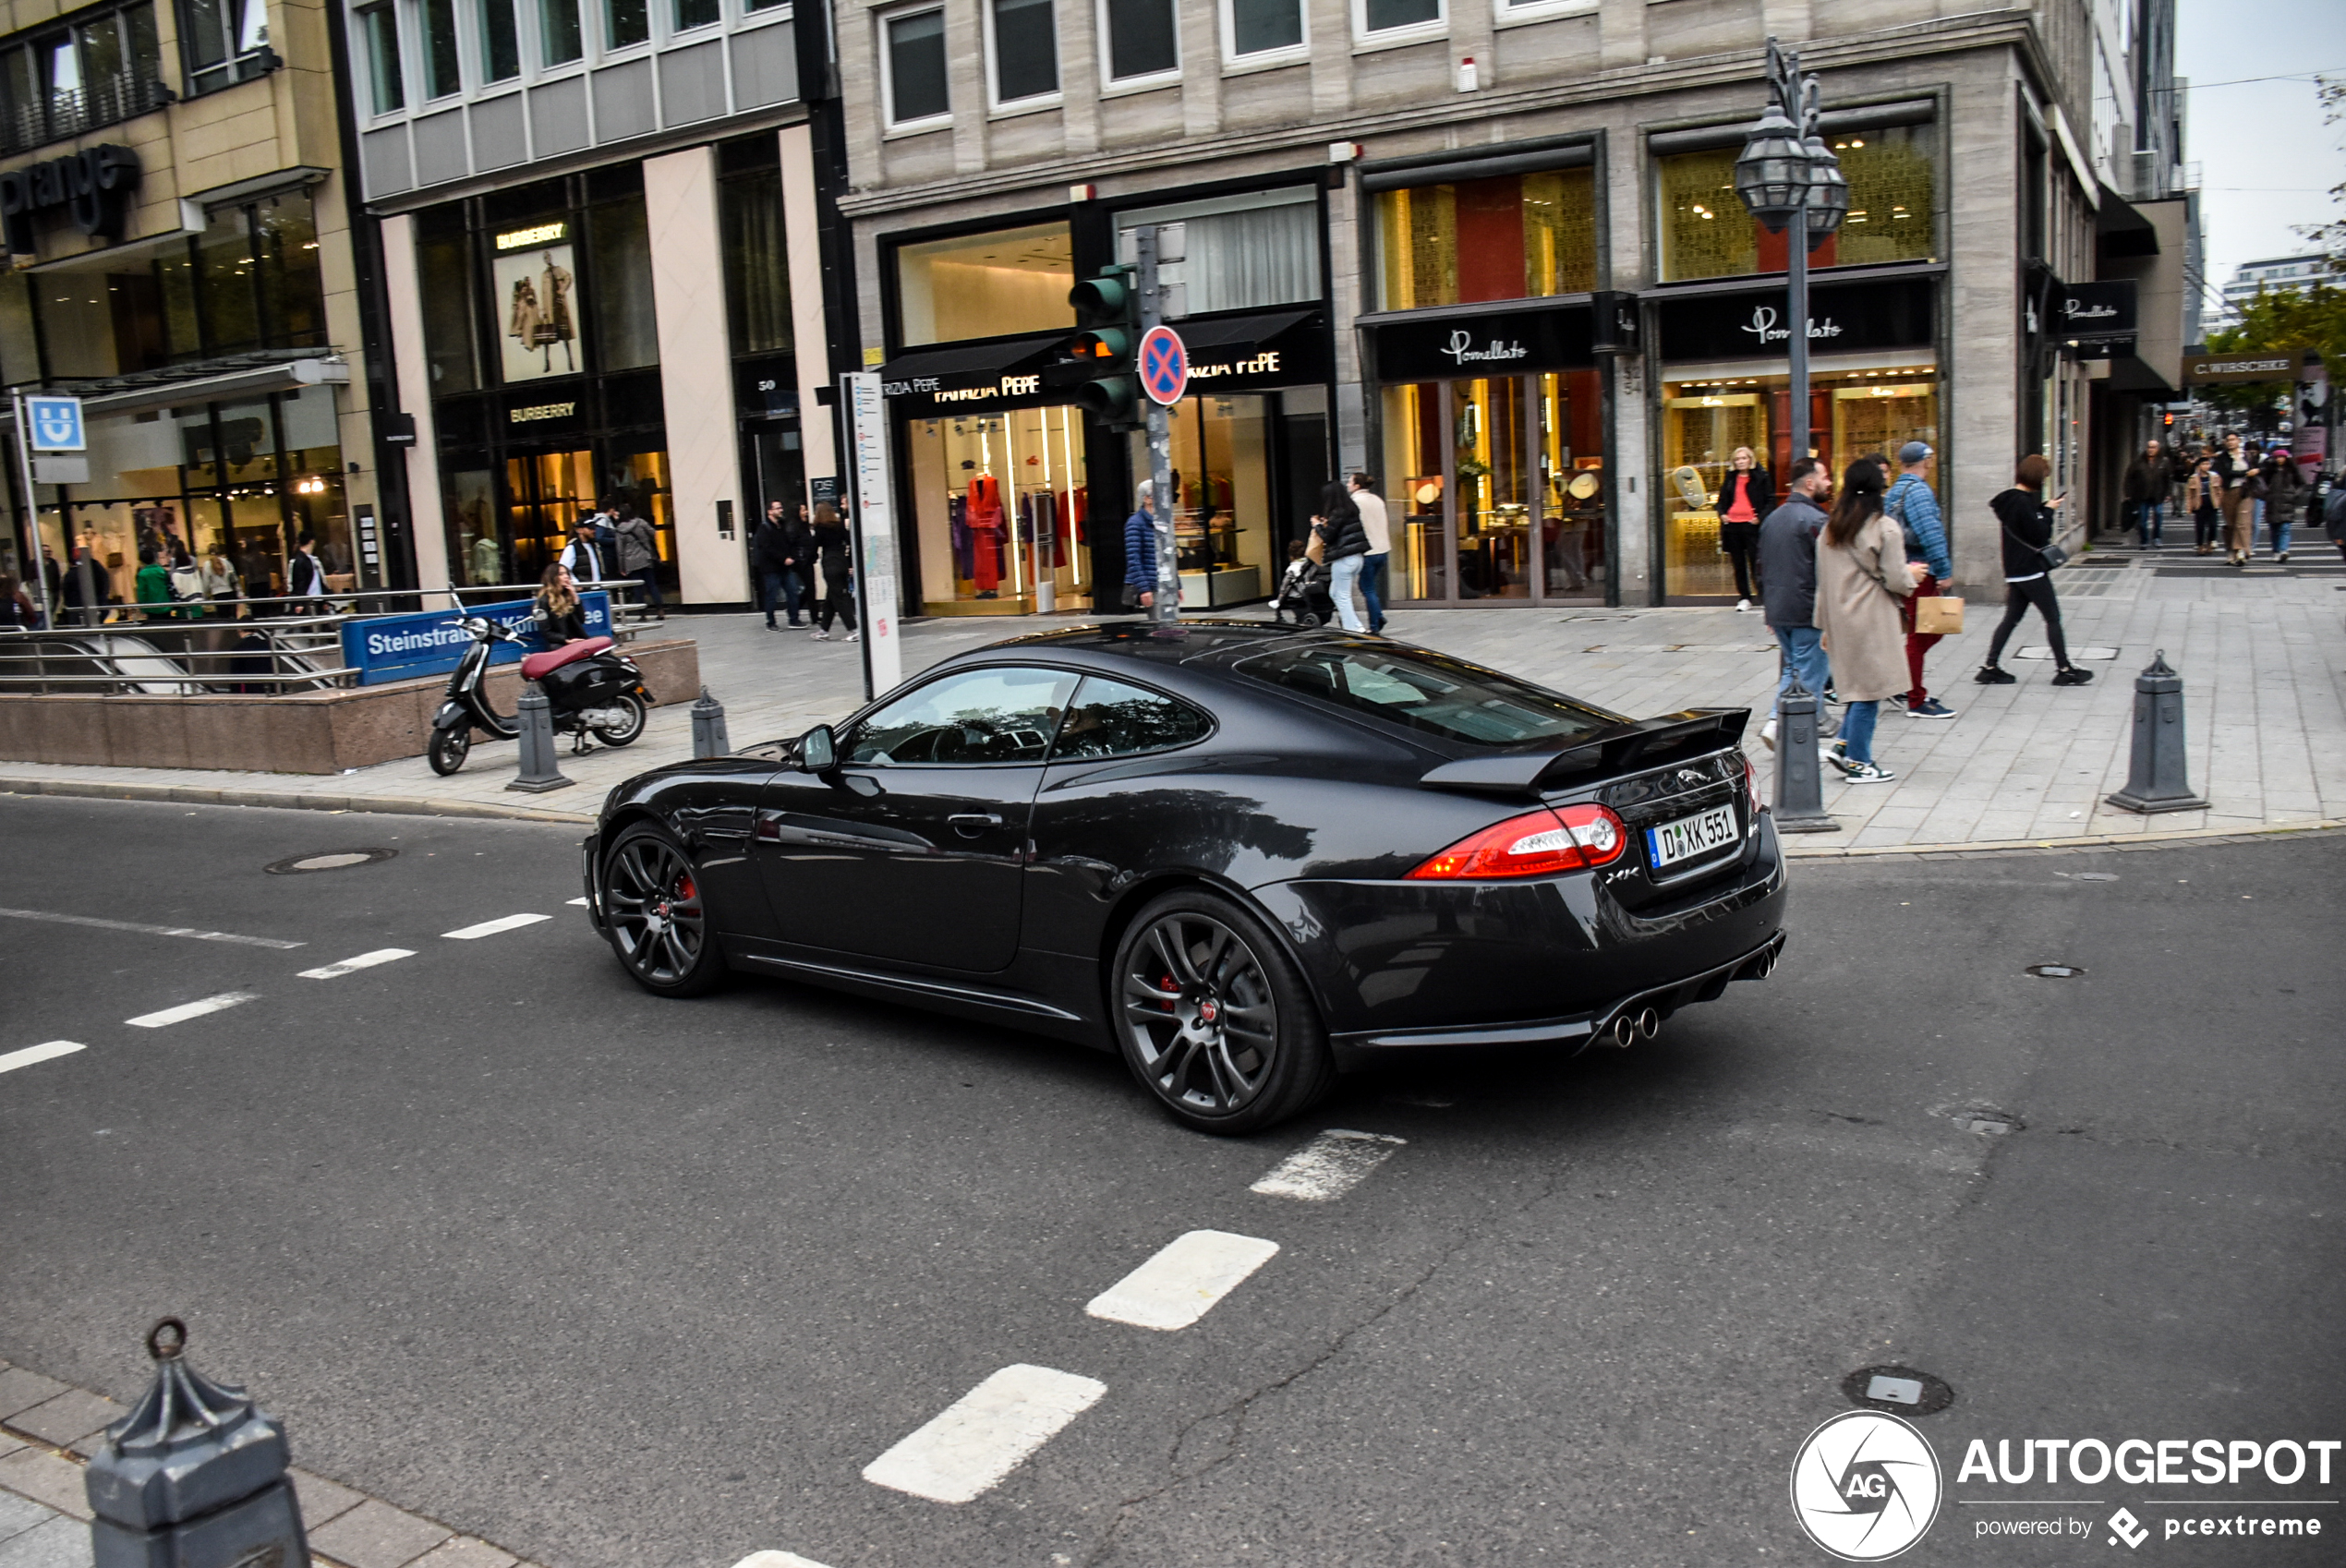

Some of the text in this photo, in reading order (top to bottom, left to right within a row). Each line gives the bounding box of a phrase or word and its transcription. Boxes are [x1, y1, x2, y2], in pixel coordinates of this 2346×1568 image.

[496, 223, 563, 249] BURBERRY
[1440, 329, 1529, 366] Pomellato
[758, 380, 777, 392] 50
[1001, 375, 1040, 397] PEPE
[510, 401, 576, 423] BURBERRY
[1662, 828, 1675, 860] D
[1684, 818, 1706, 853] XK
[1706, 810, 1733, 844] 551
[1651, 852, 1658, 862] D
